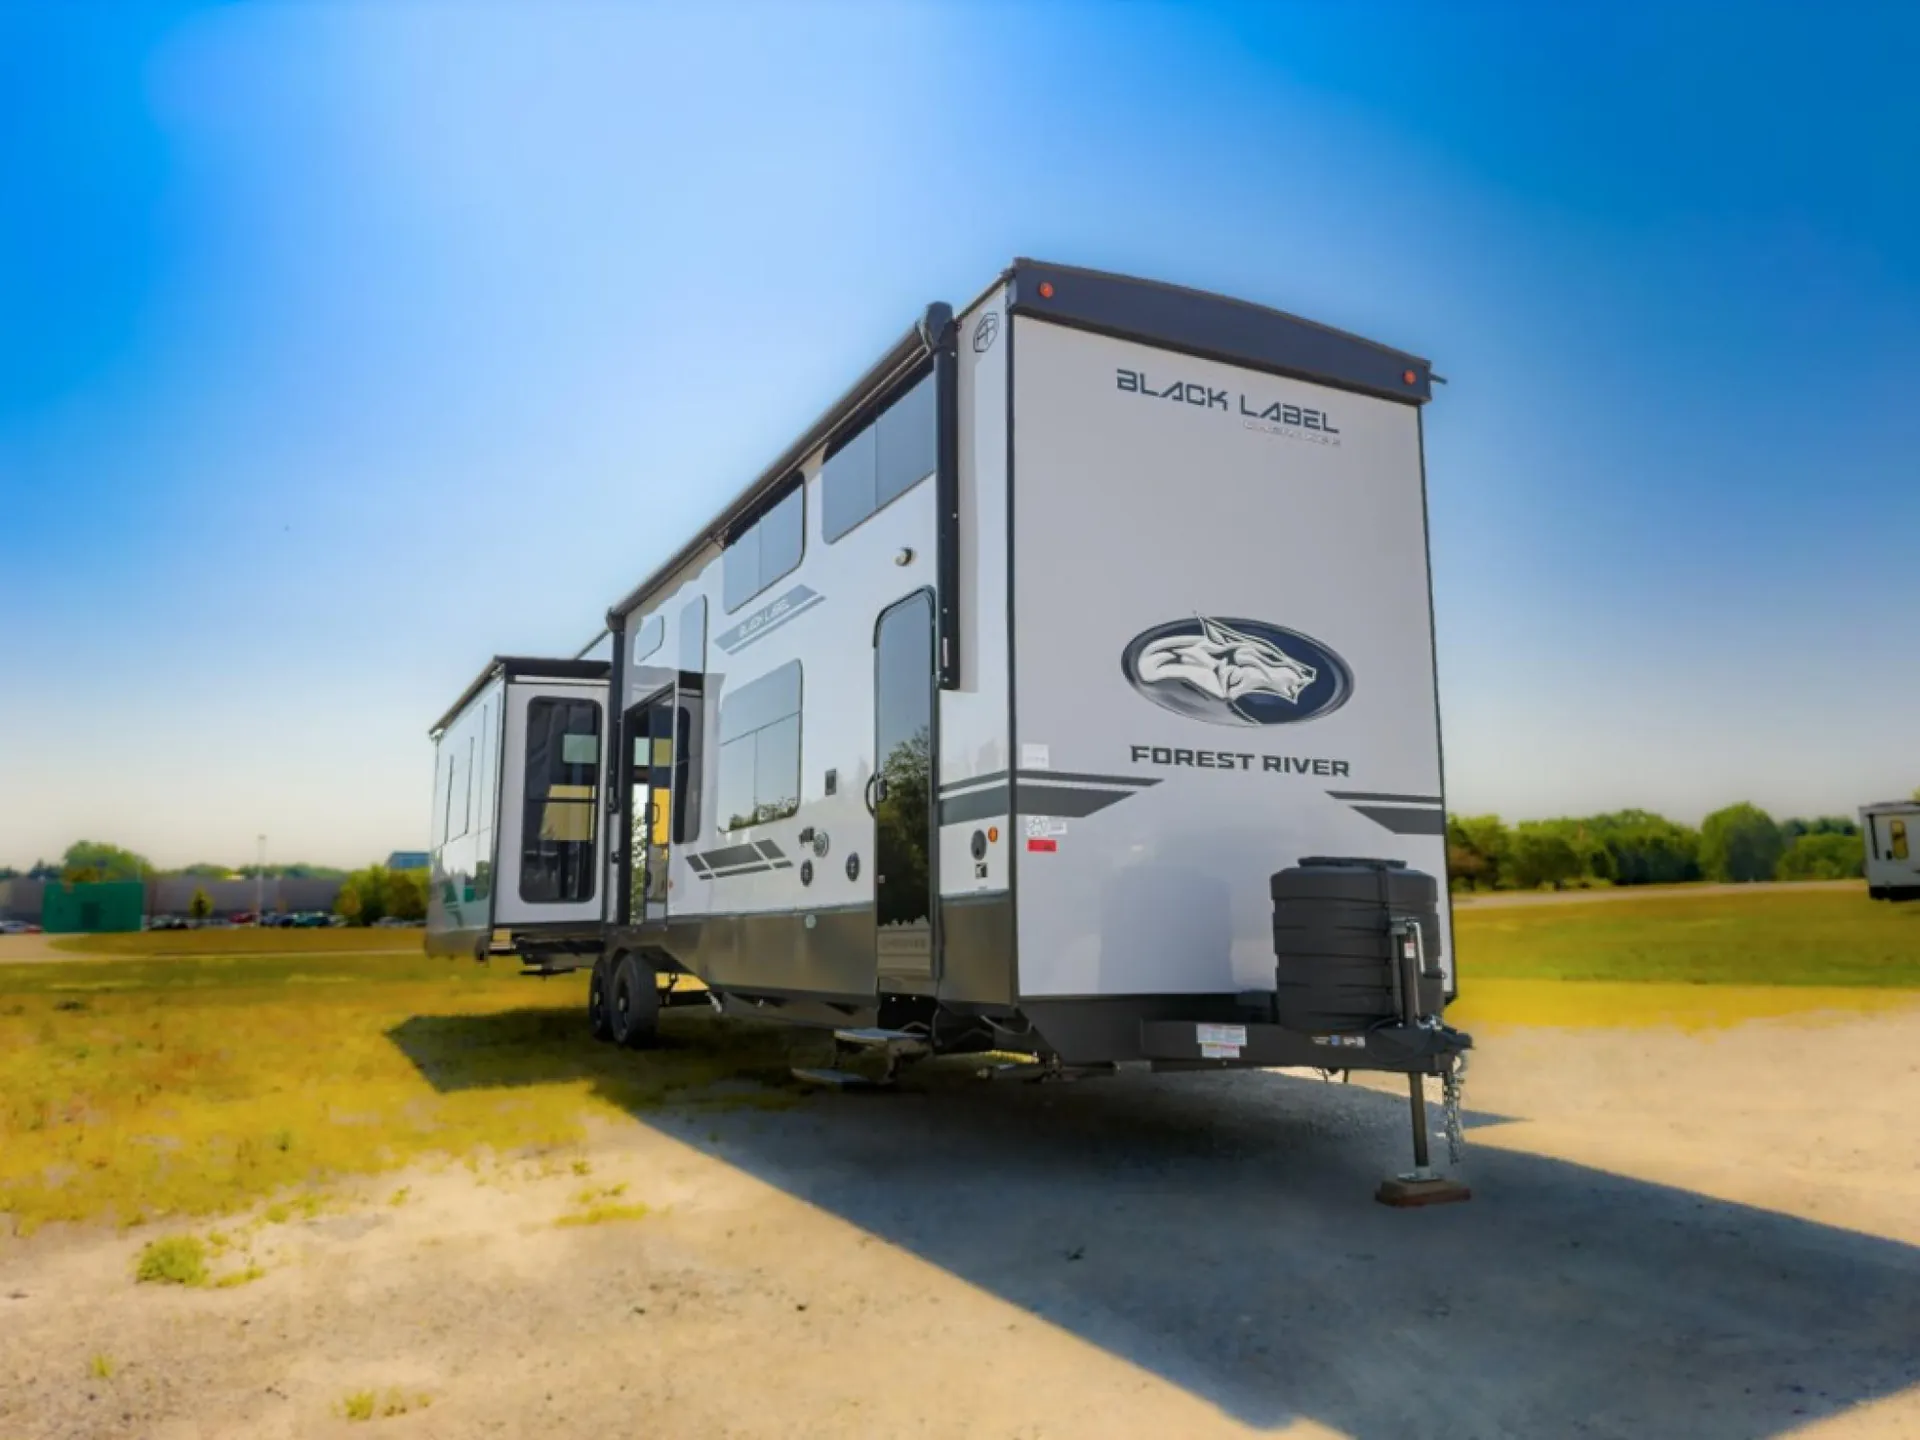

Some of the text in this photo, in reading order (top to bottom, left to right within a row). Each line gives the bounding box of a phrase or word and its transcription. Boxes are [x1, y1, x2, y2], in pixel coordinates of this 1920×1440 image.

[1116, 368, 1229, 411] BLACK
[1240, 394, 1340, 434] LABEL
[1130, 745, 1349, 777] FOREST RIVER
